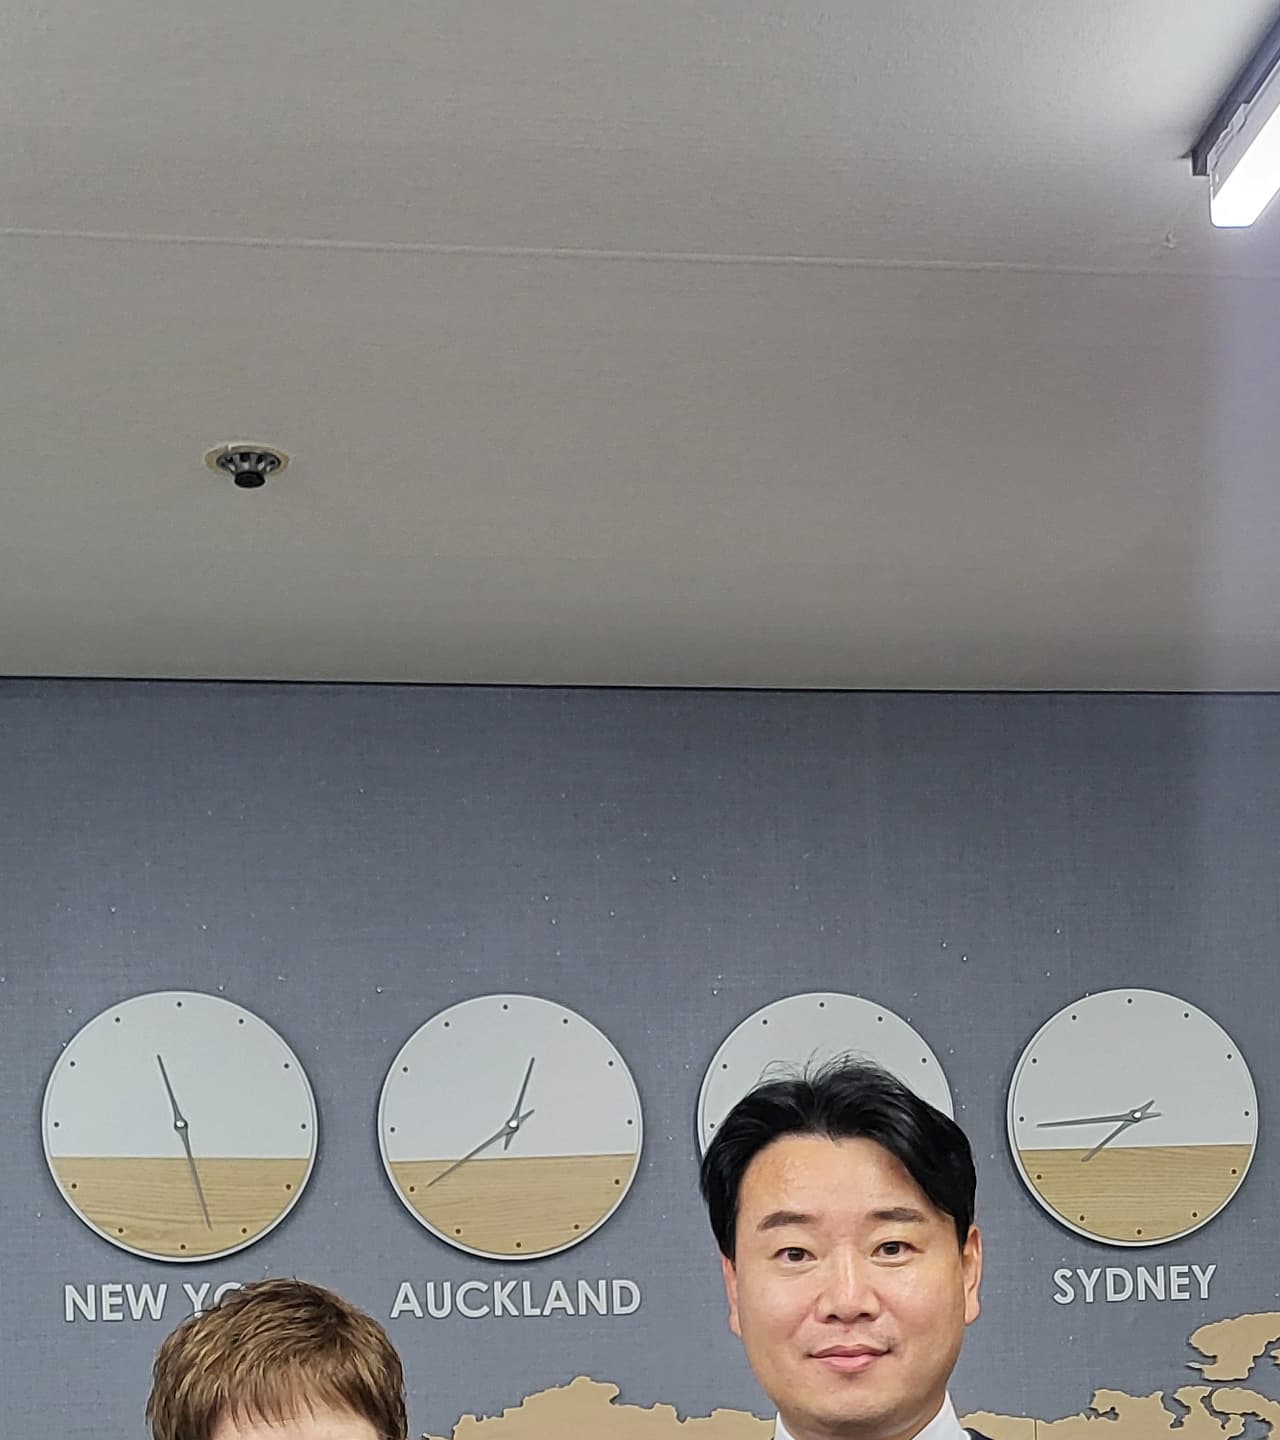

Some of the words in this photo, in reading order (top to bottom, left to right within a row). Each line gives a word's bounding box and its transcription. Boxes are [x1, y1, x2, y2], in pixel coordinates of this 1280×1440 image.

[65, 1282, 167, 1321] NEW
[390, 1279, 641, 1319] AUCKLAND
[1053, 1265, 1217, 1304] SYDNEY
